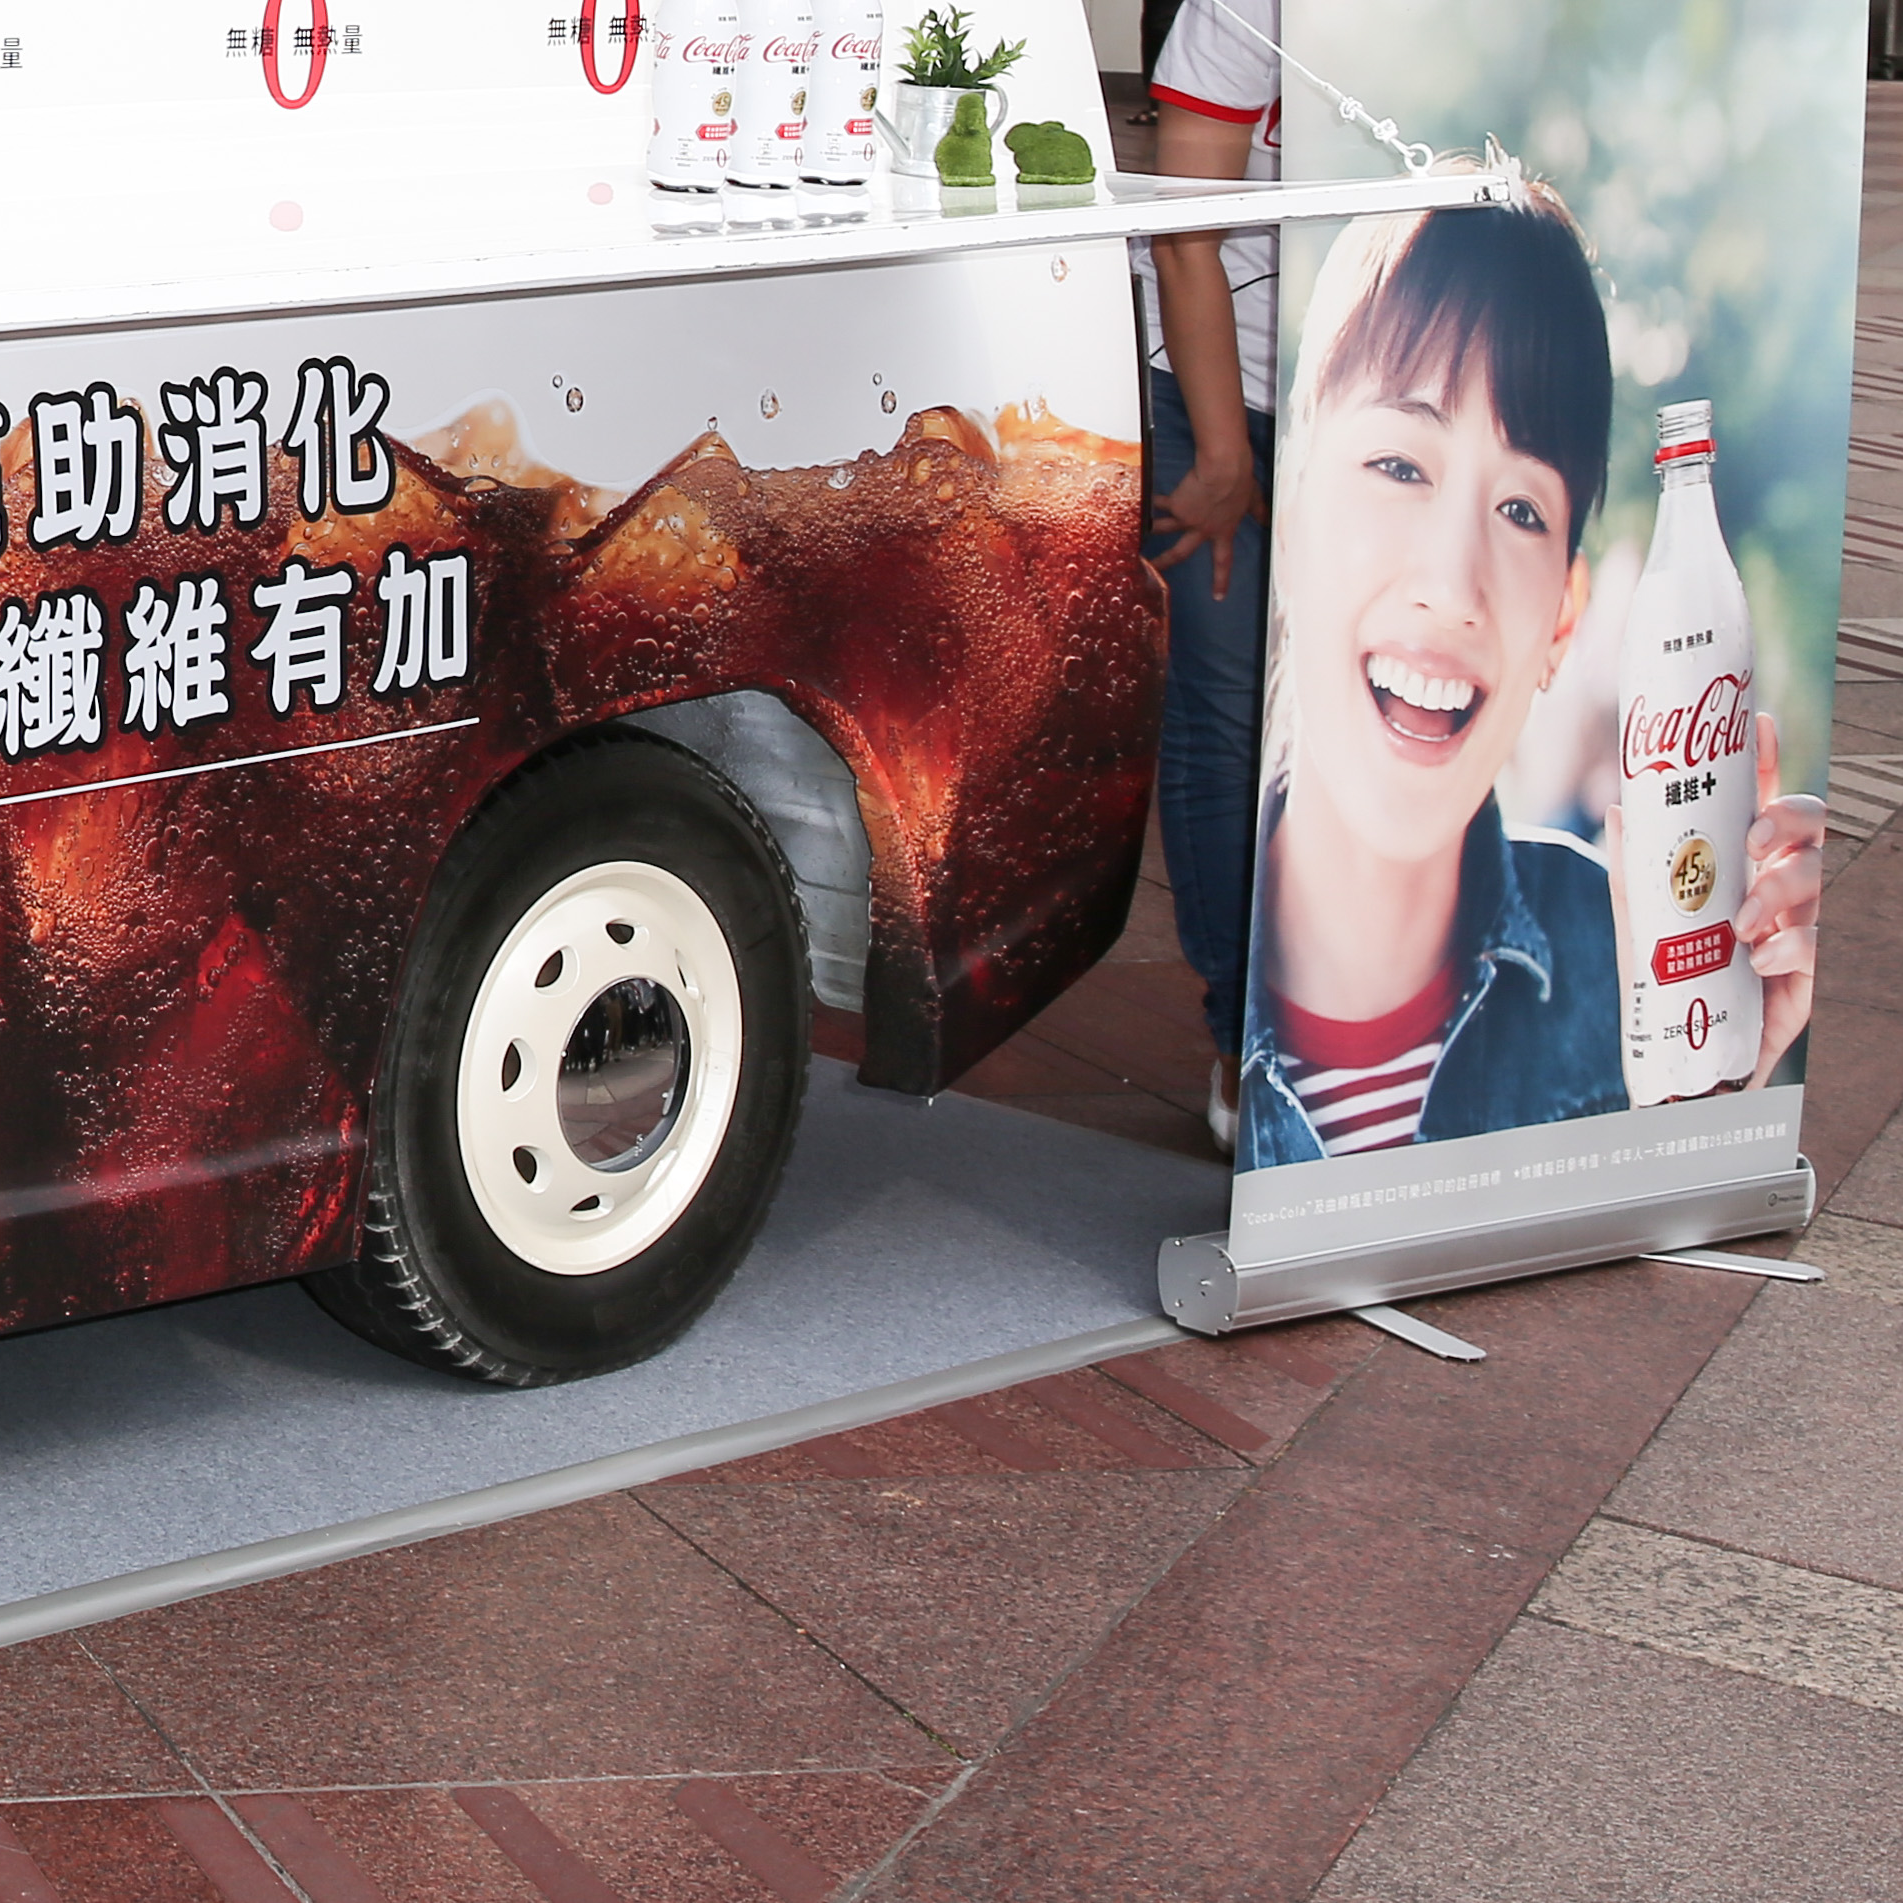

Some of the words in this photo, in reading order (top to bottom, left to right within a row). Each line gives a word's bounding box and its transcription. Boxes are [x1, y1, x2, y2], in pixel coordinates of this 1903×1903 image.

[225, 27, 274, 59] 無糖
[293, 24, 363, 57] 無熱量
[547, 16, 592, 47] 無糖
[608, 14, 656, 45] 無熱
[1623, 667, 1753, 780] Coca-Cola
